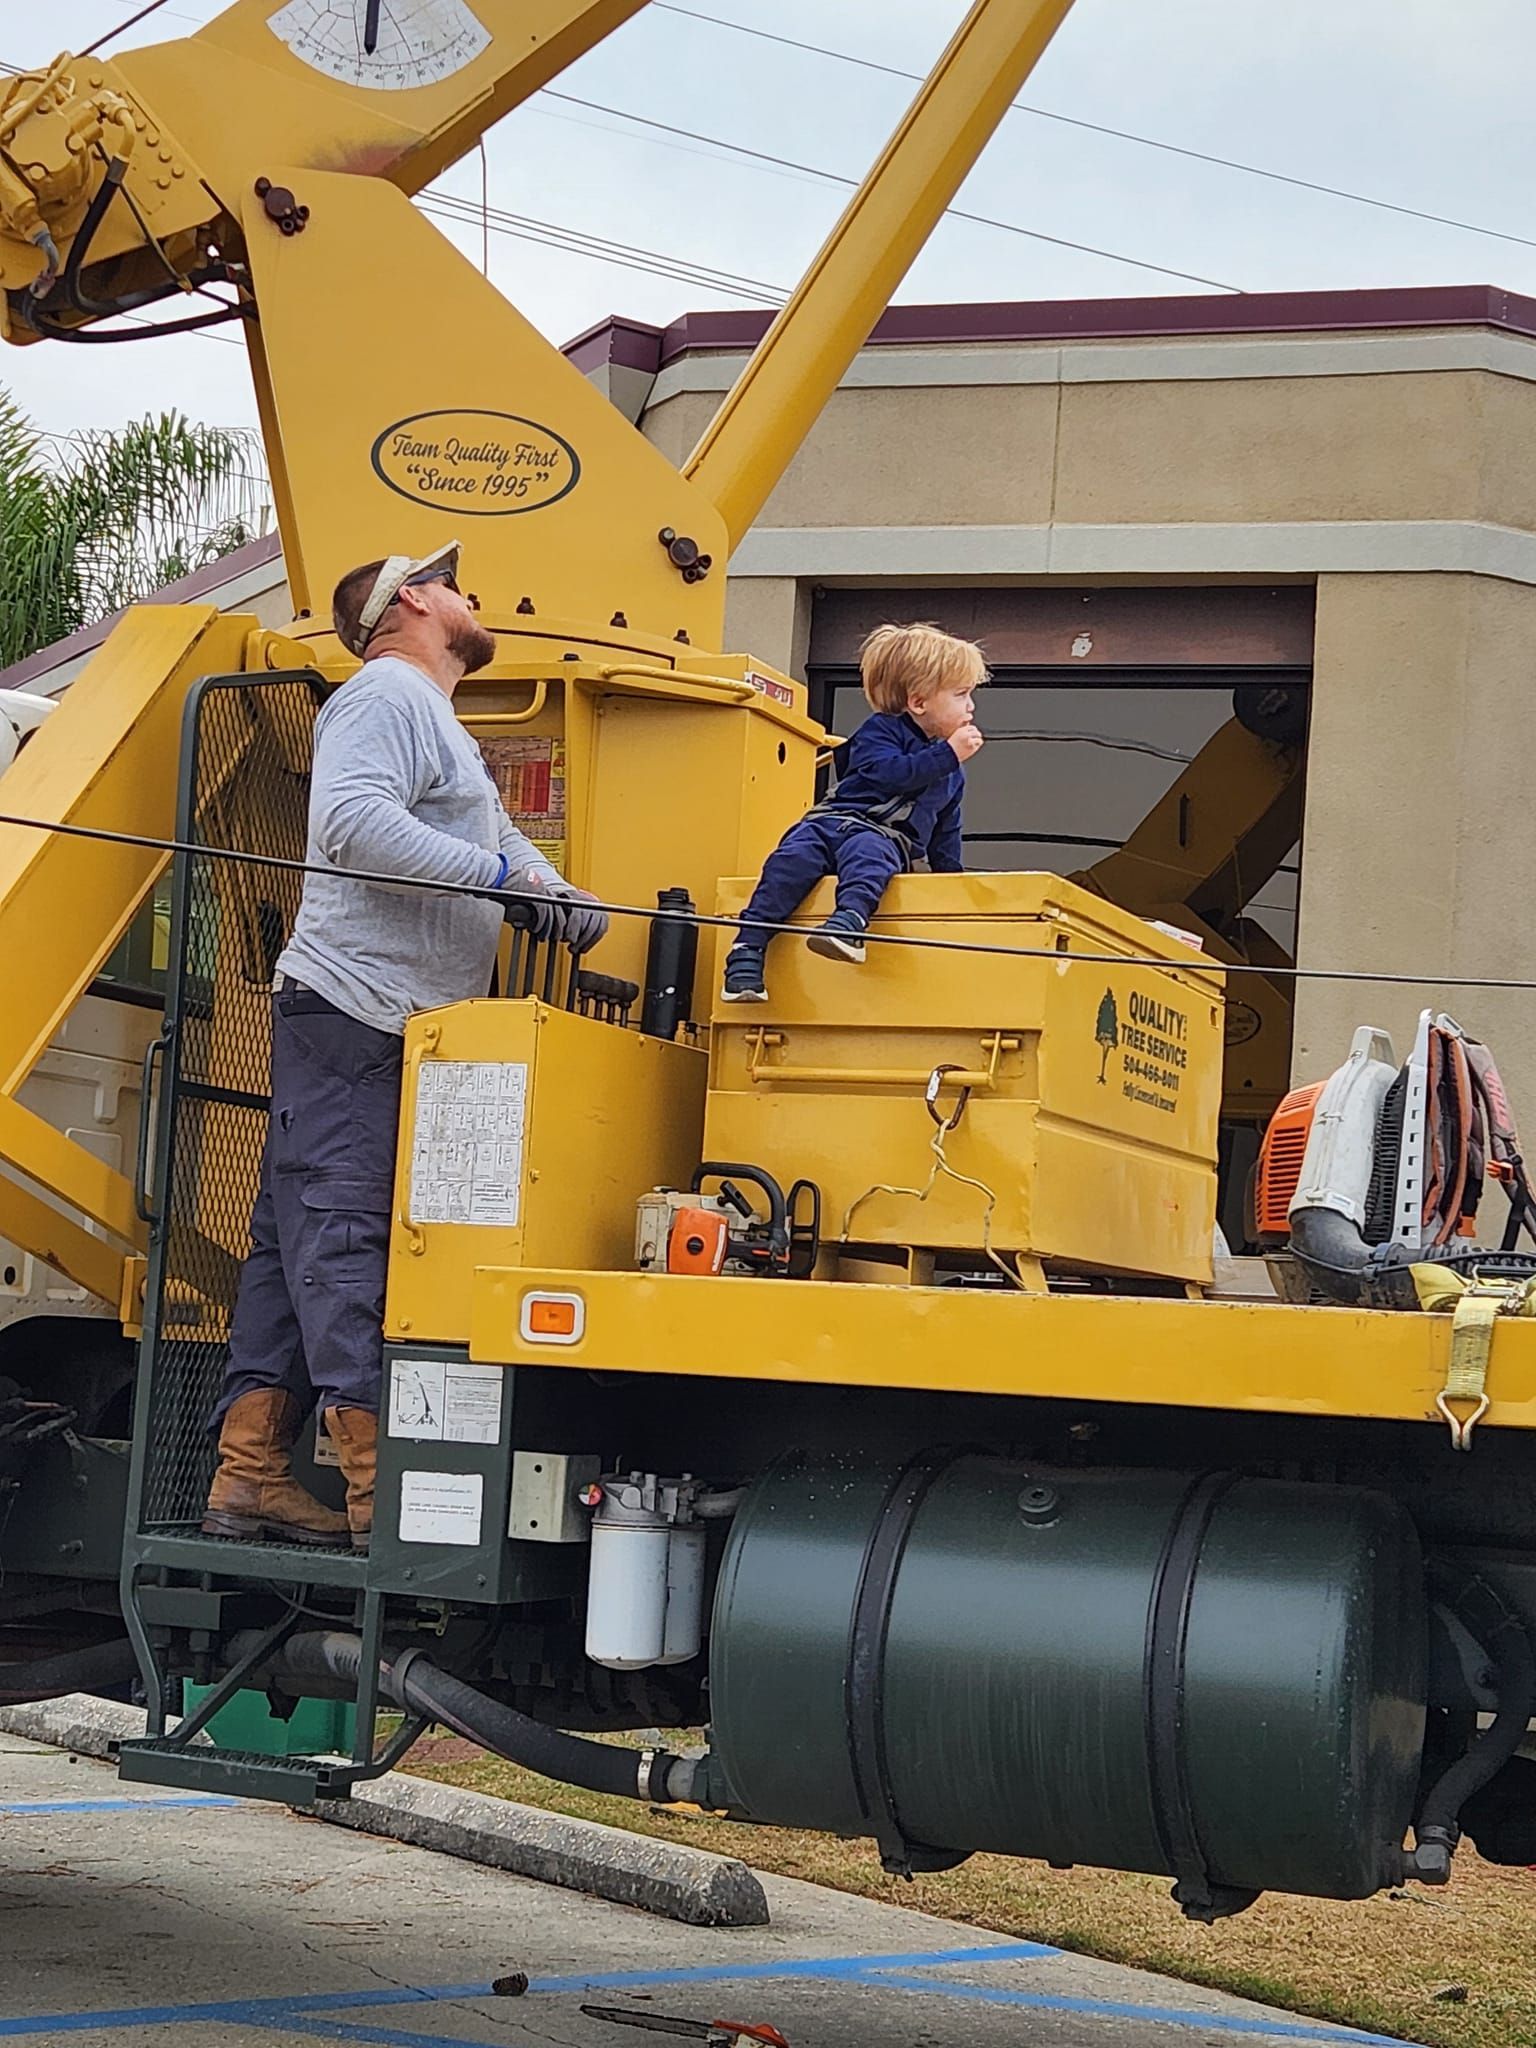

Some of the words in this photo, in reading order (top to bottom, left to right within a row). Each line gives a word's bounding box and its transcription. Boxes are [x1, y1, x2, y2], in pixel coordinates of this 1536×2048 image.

[392, 433, 440, 458] Team
[444, 438, 511, 471] Quality
[513, 443, 559, 468] First
[1129, 990, 1185, 1041] QUALITY
[1121, 1022, 1146, 1053] TREE
[1147, 1034, 1187, 1070] SERVICE
